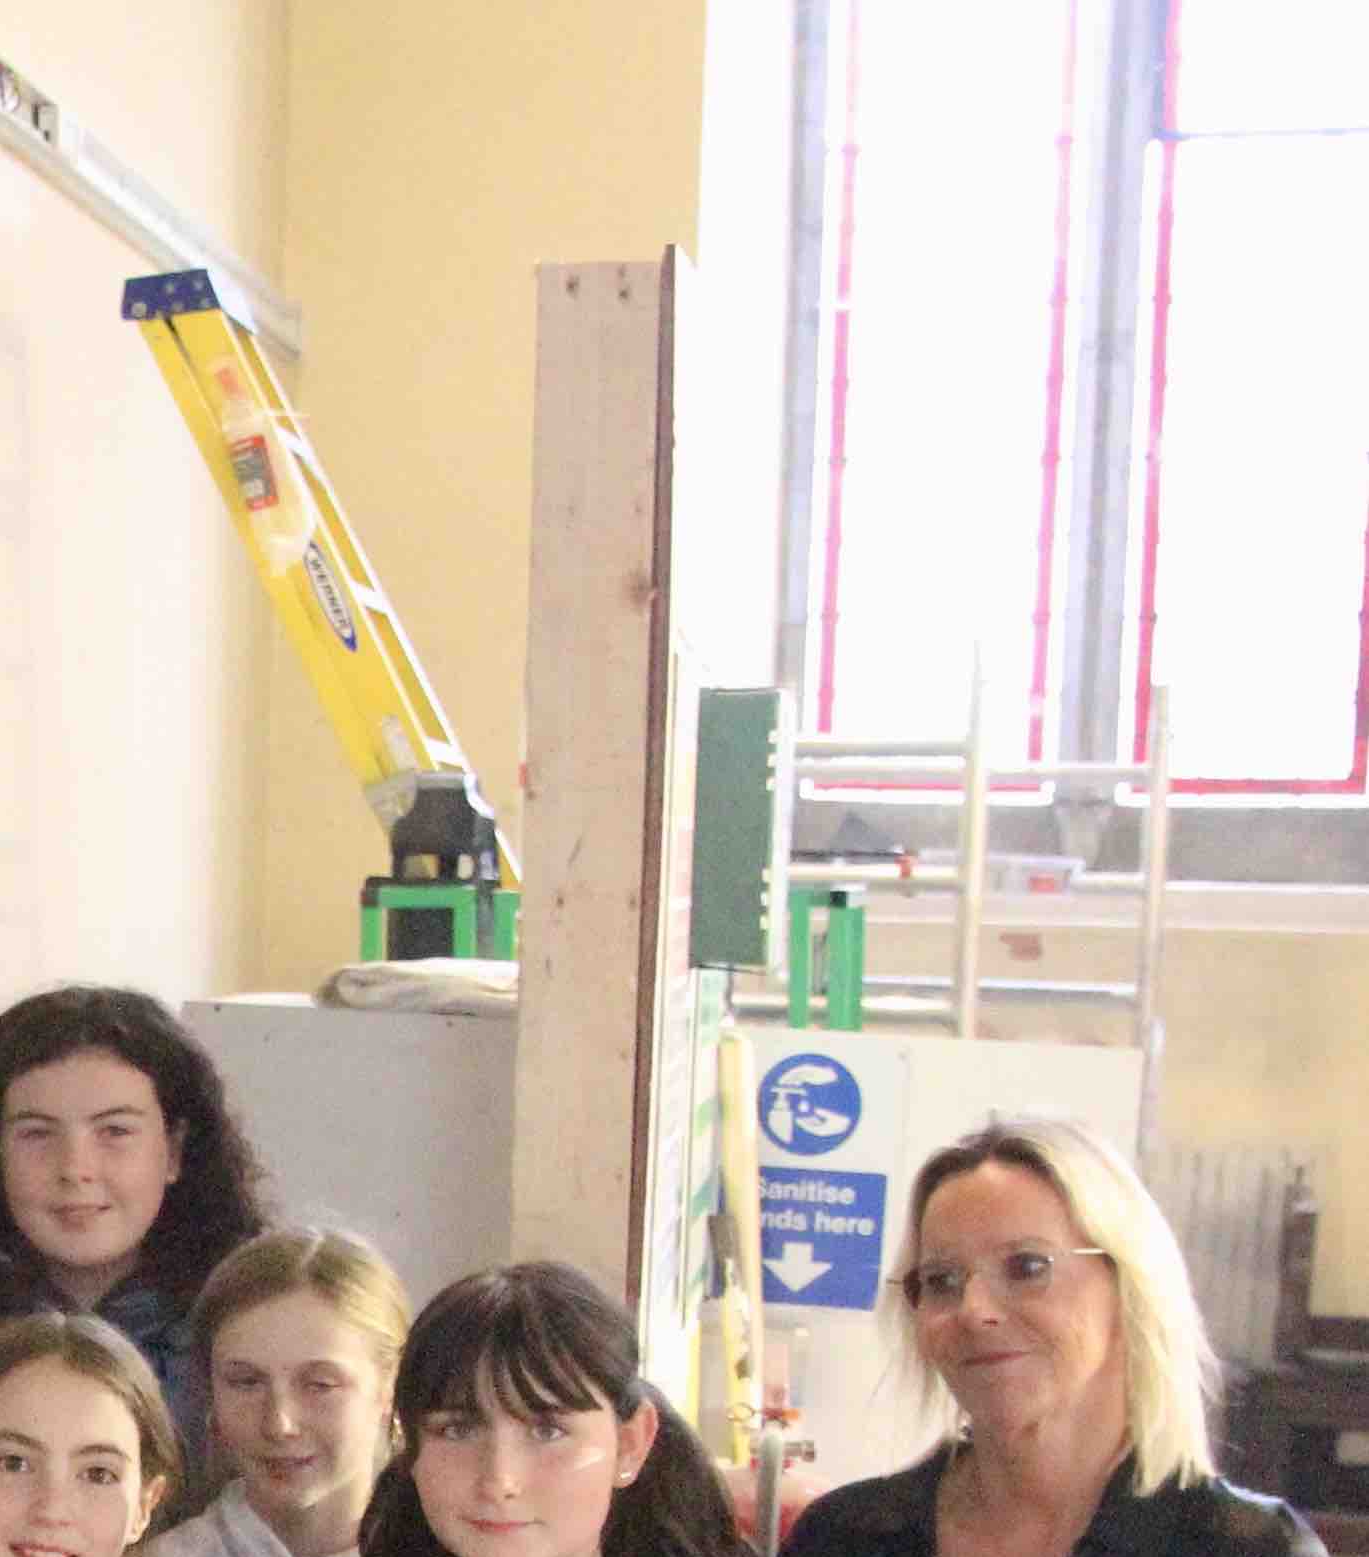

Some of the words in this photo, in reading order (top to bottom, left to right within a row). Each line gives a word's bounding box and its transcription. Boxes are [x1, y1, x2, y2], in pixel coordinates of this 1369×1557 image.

[309, 557, 347, 627] WERNER
[761, 1209, 807, 1231] nds
[814, 1210, 875, 1236] here
